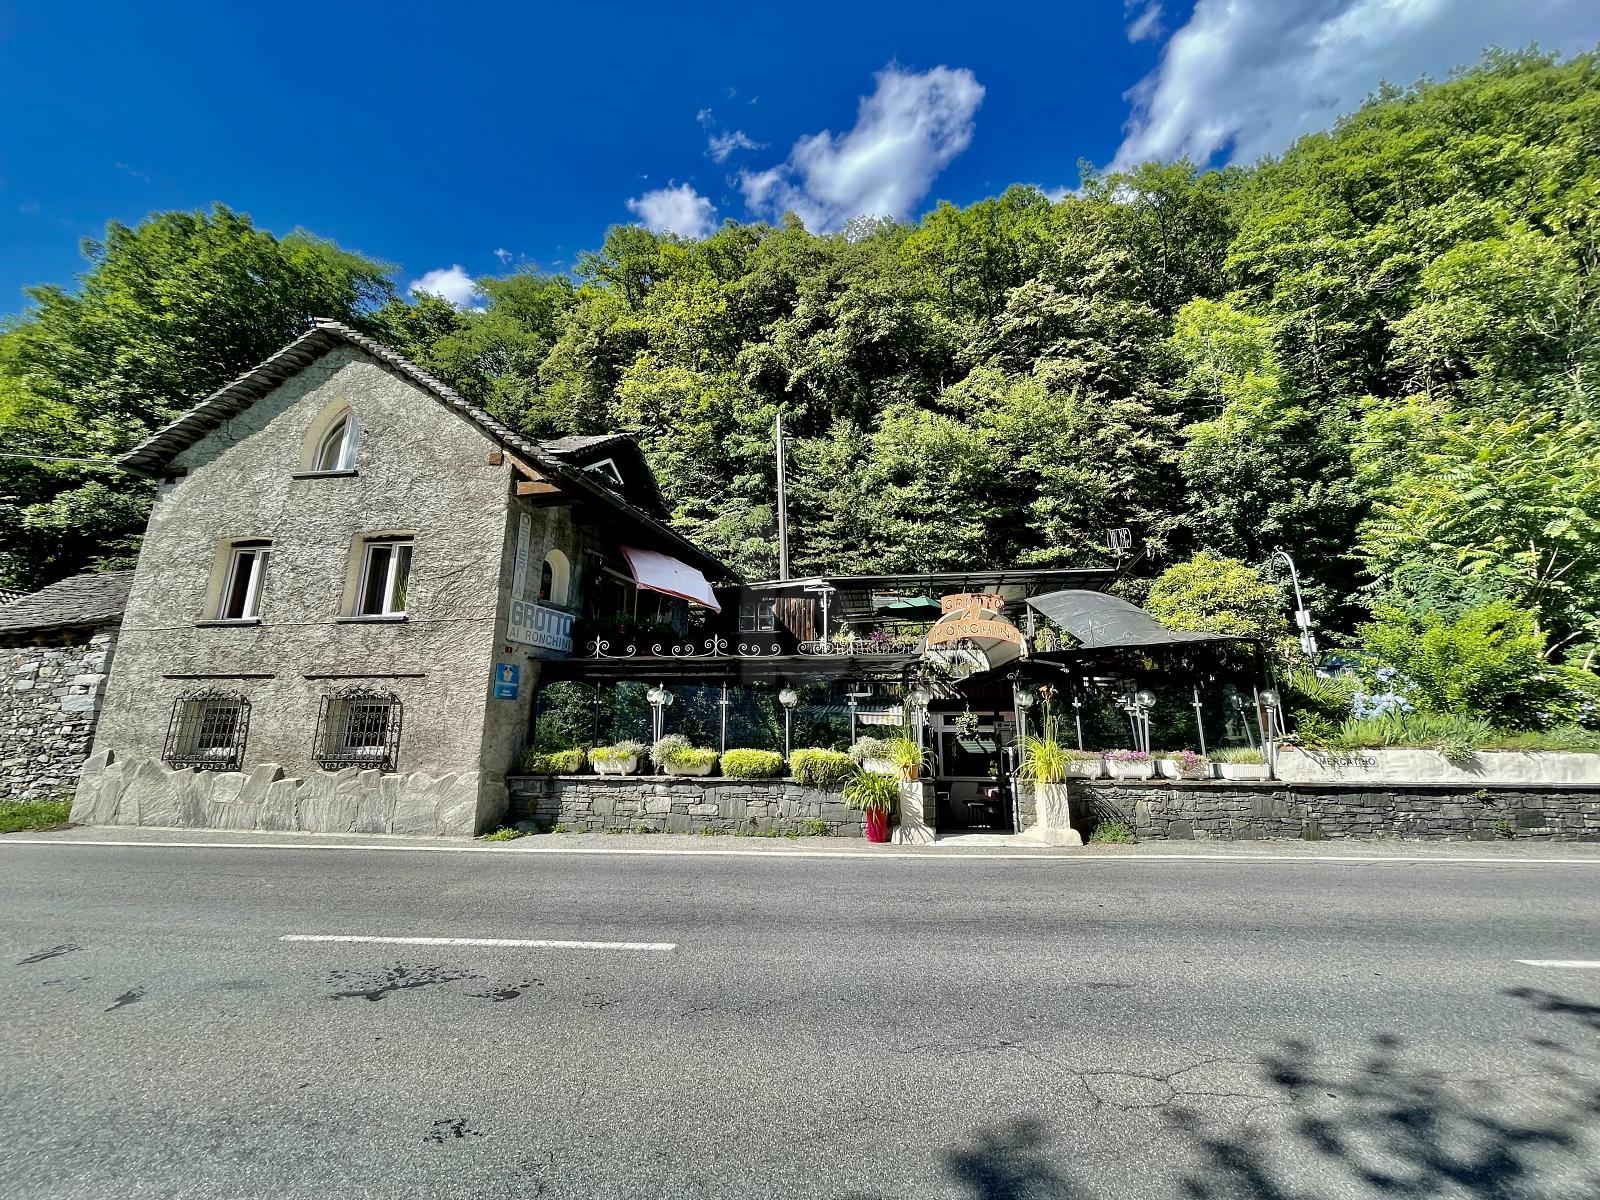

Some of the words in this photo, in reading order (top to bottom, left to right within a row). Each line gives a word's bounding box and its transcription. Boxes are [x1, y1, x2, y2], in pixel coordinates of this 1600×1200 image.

[513, 514, 531, 598] OSTERIA
[944, 597, 1004, 611] GROTTO
[511, 601, 575, 638] GROTTO
[525, 630, 573, 650] RONCHINI
[933, 623, 1017, 641] RONCHINI
